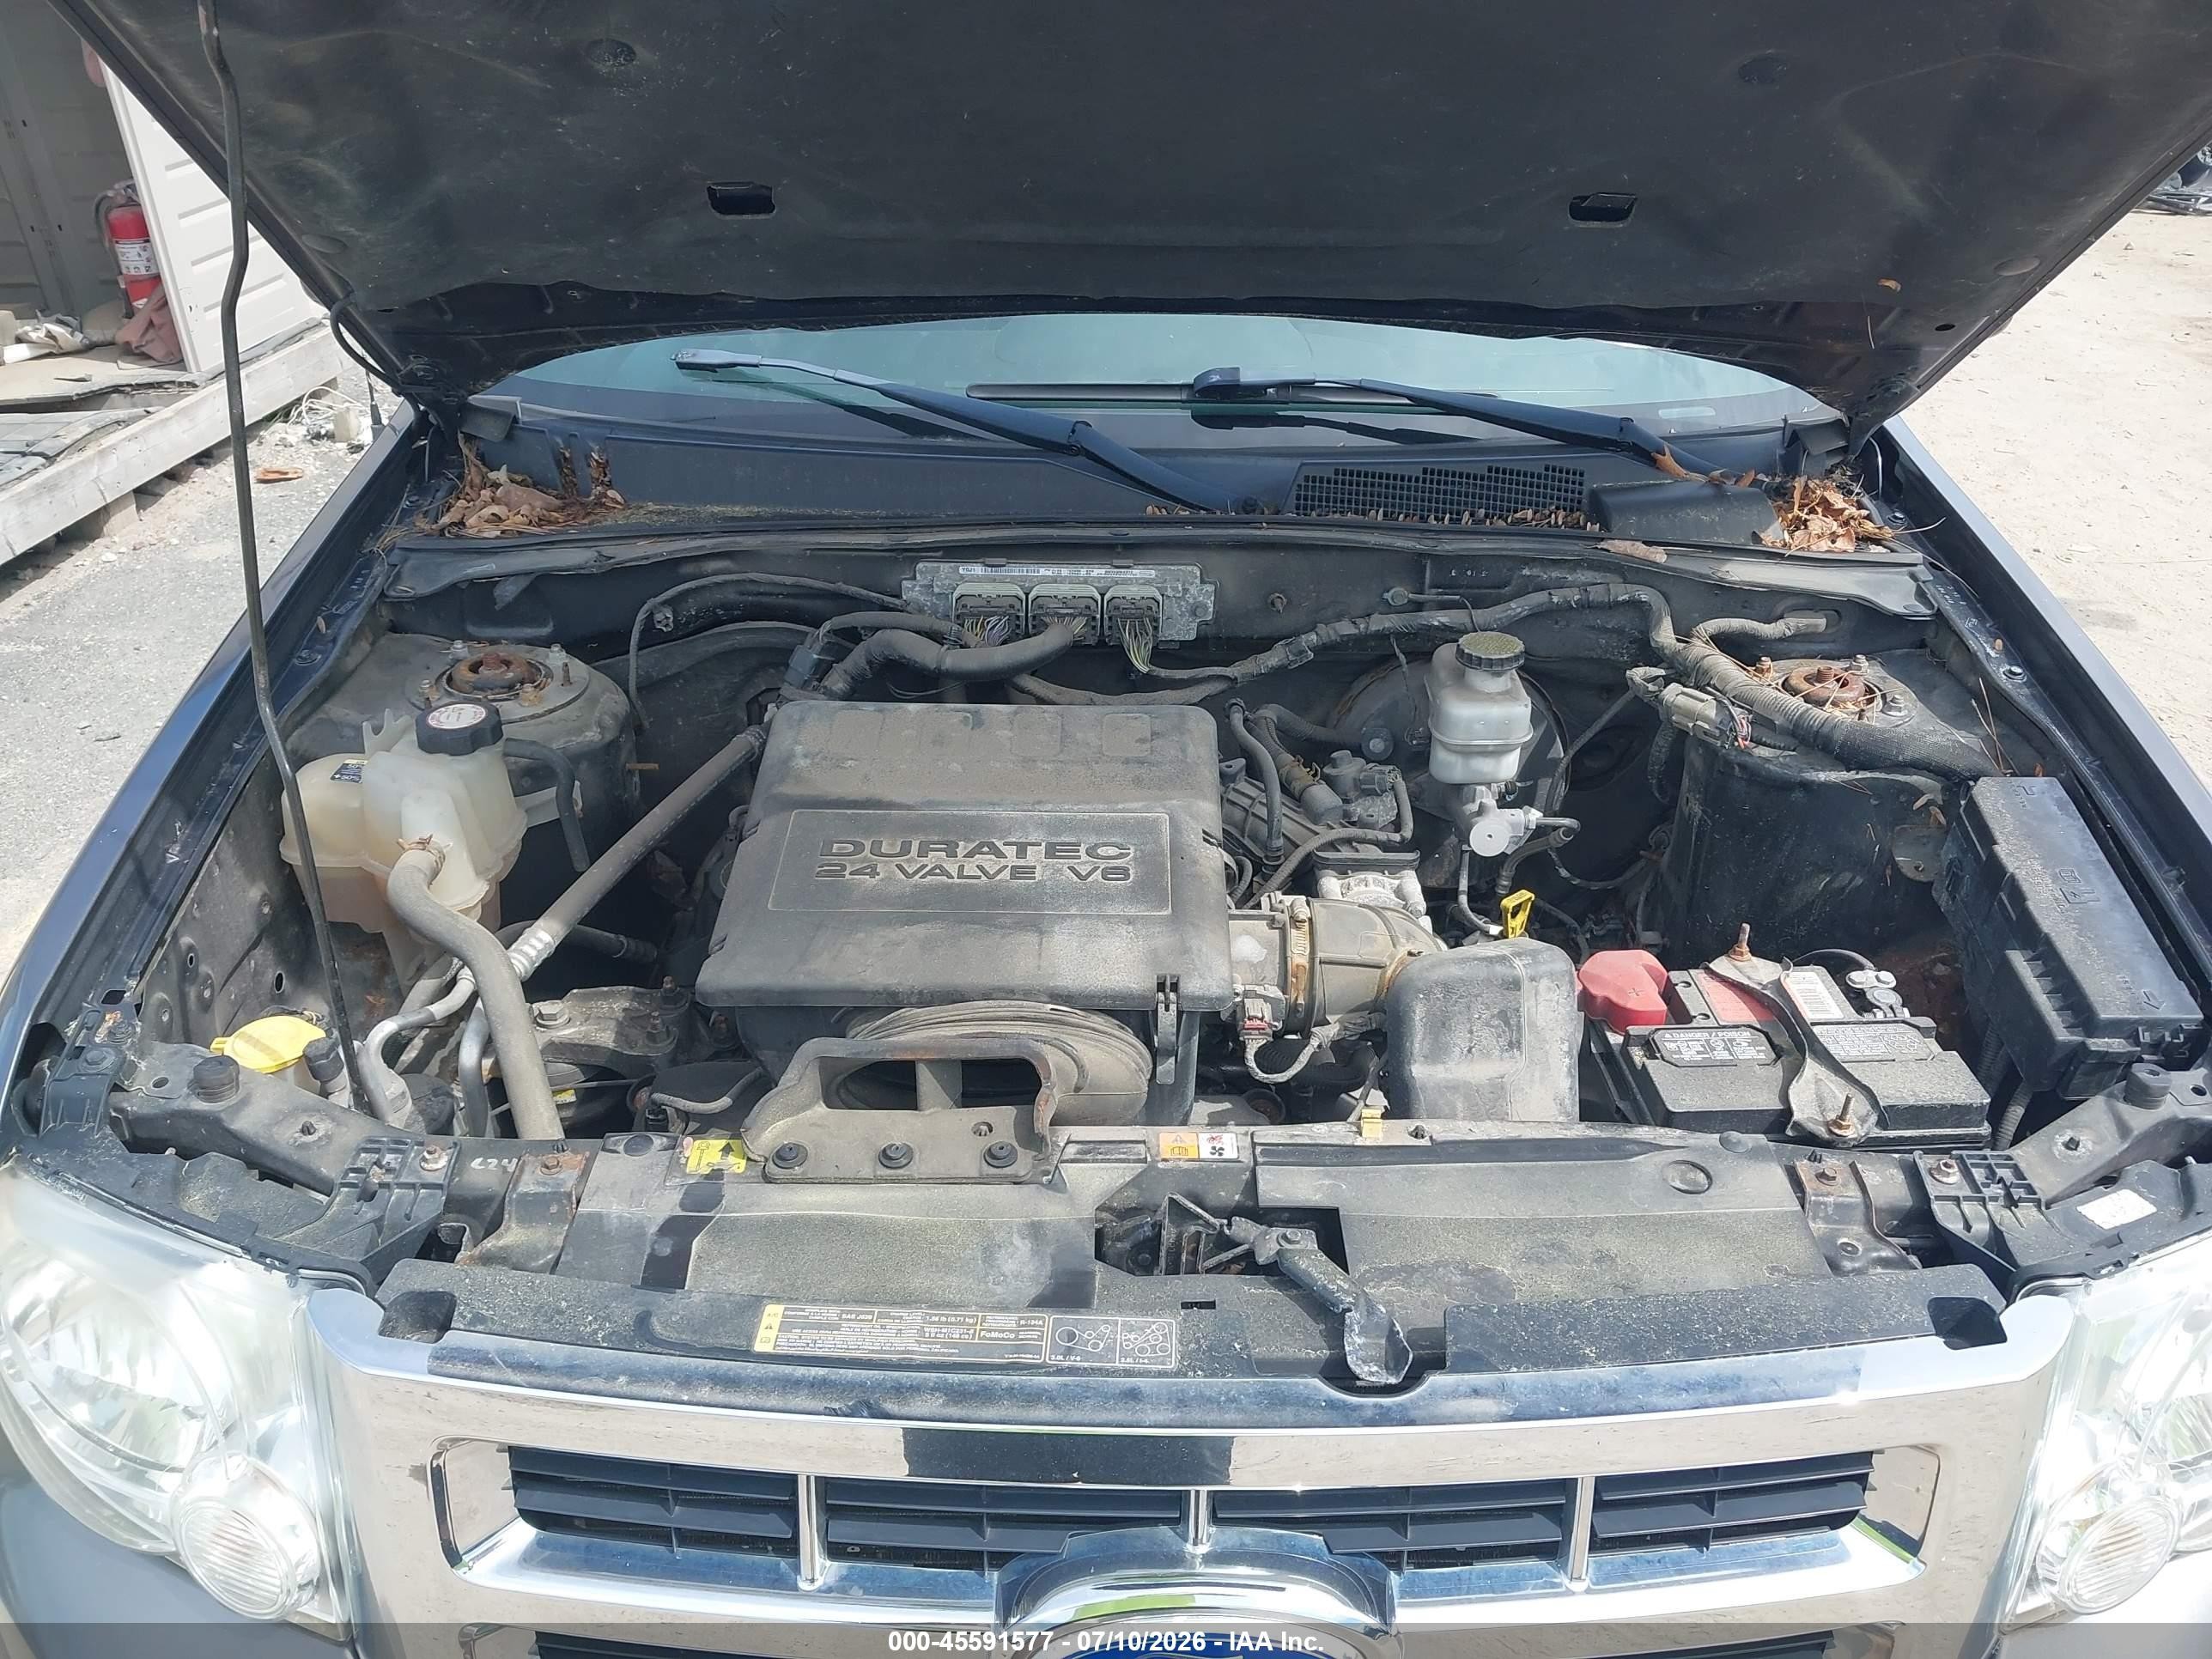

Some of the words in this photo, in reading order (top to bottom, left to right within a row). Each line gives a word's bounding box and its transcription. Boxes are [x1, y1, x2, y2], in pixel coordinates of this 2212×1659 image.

[820, 839, 1131, 860] DURATEC
[816, 862, 881, 879] 24
[895, 863, 1037, 881] VALVE
[1066, 865, 1131, 882] V6
[980, 1330, 1015, 1339] FoMoCo
